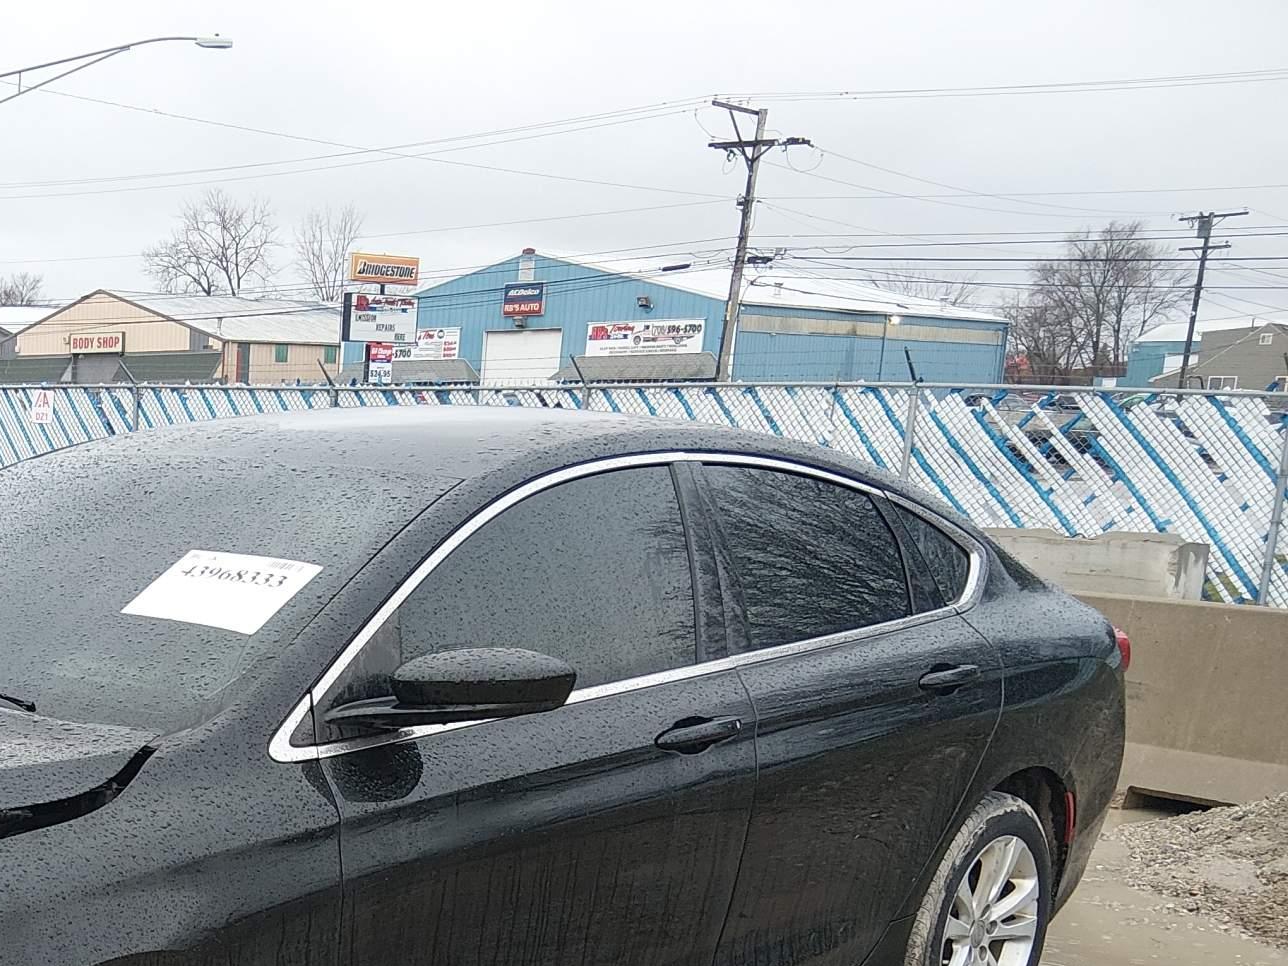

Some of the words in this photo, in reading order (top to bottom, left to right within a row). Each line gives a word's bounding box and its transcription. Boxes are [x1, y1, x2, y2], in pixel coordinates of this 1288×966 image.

[357, 261, 415, 278] BRIDGESTONE
[520, 303, 540, 311] AUTO
[376, 323, 396, 332] REPAIRS
[72, 337, 94, 349] BODY
[97, 336, 120, 348] SHOP
[180, 564, 289, 588] 43968333
